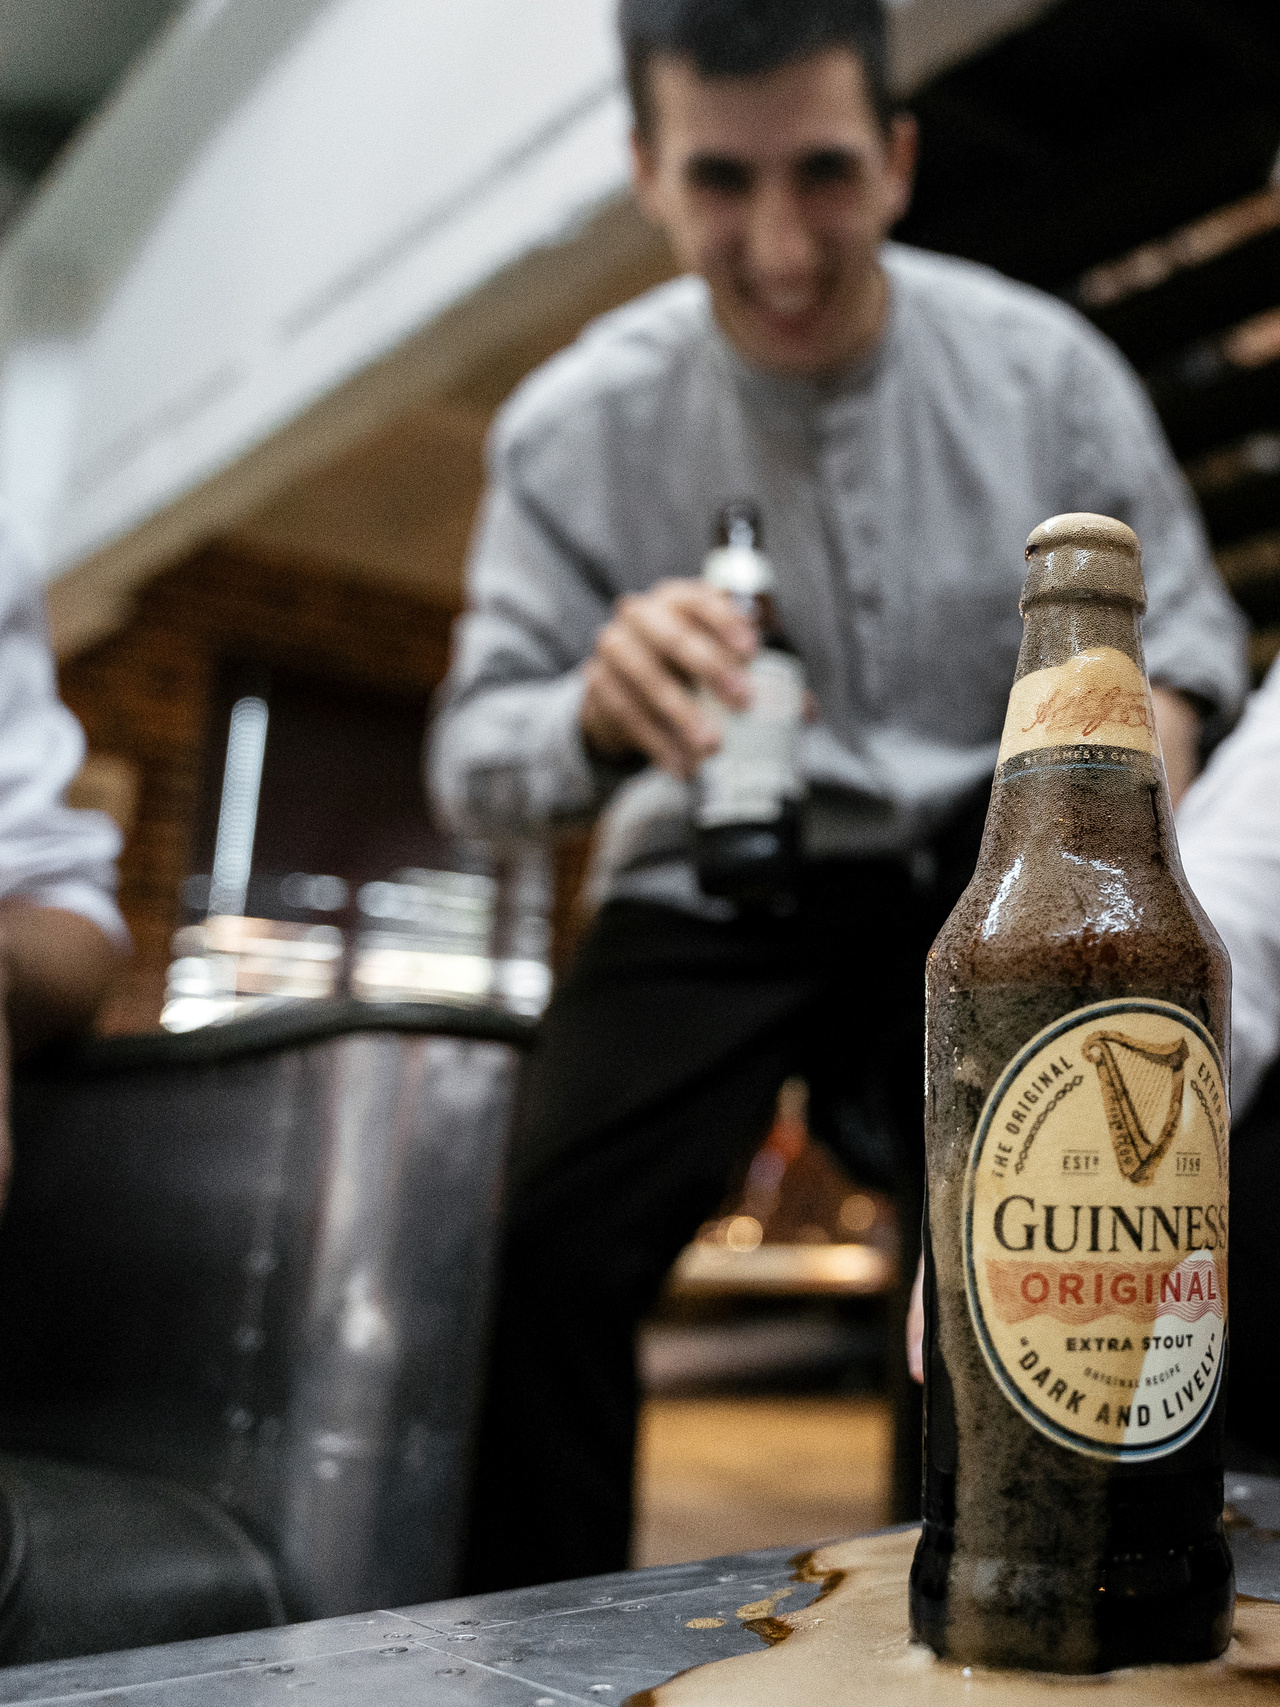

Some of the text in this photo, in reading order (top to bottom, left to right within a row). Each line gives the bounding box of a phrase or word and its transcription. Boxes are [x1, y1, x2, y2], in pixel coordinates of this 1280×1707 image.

[1047, 750, 1104, 761] AMES'S
[991, 1056, 1074, 1178] THE ORIGINAL
[993, 1194, 1228, 1252] GUINNESS
[1020, 1270, 1217, 1305] ORIGINAL
[1065, 1333, 1194, 1352] EXTRA STOUT
[1145, 1363, 1181, 1387] RECIPE
[1095, 1401, 1151, 1427] AND
